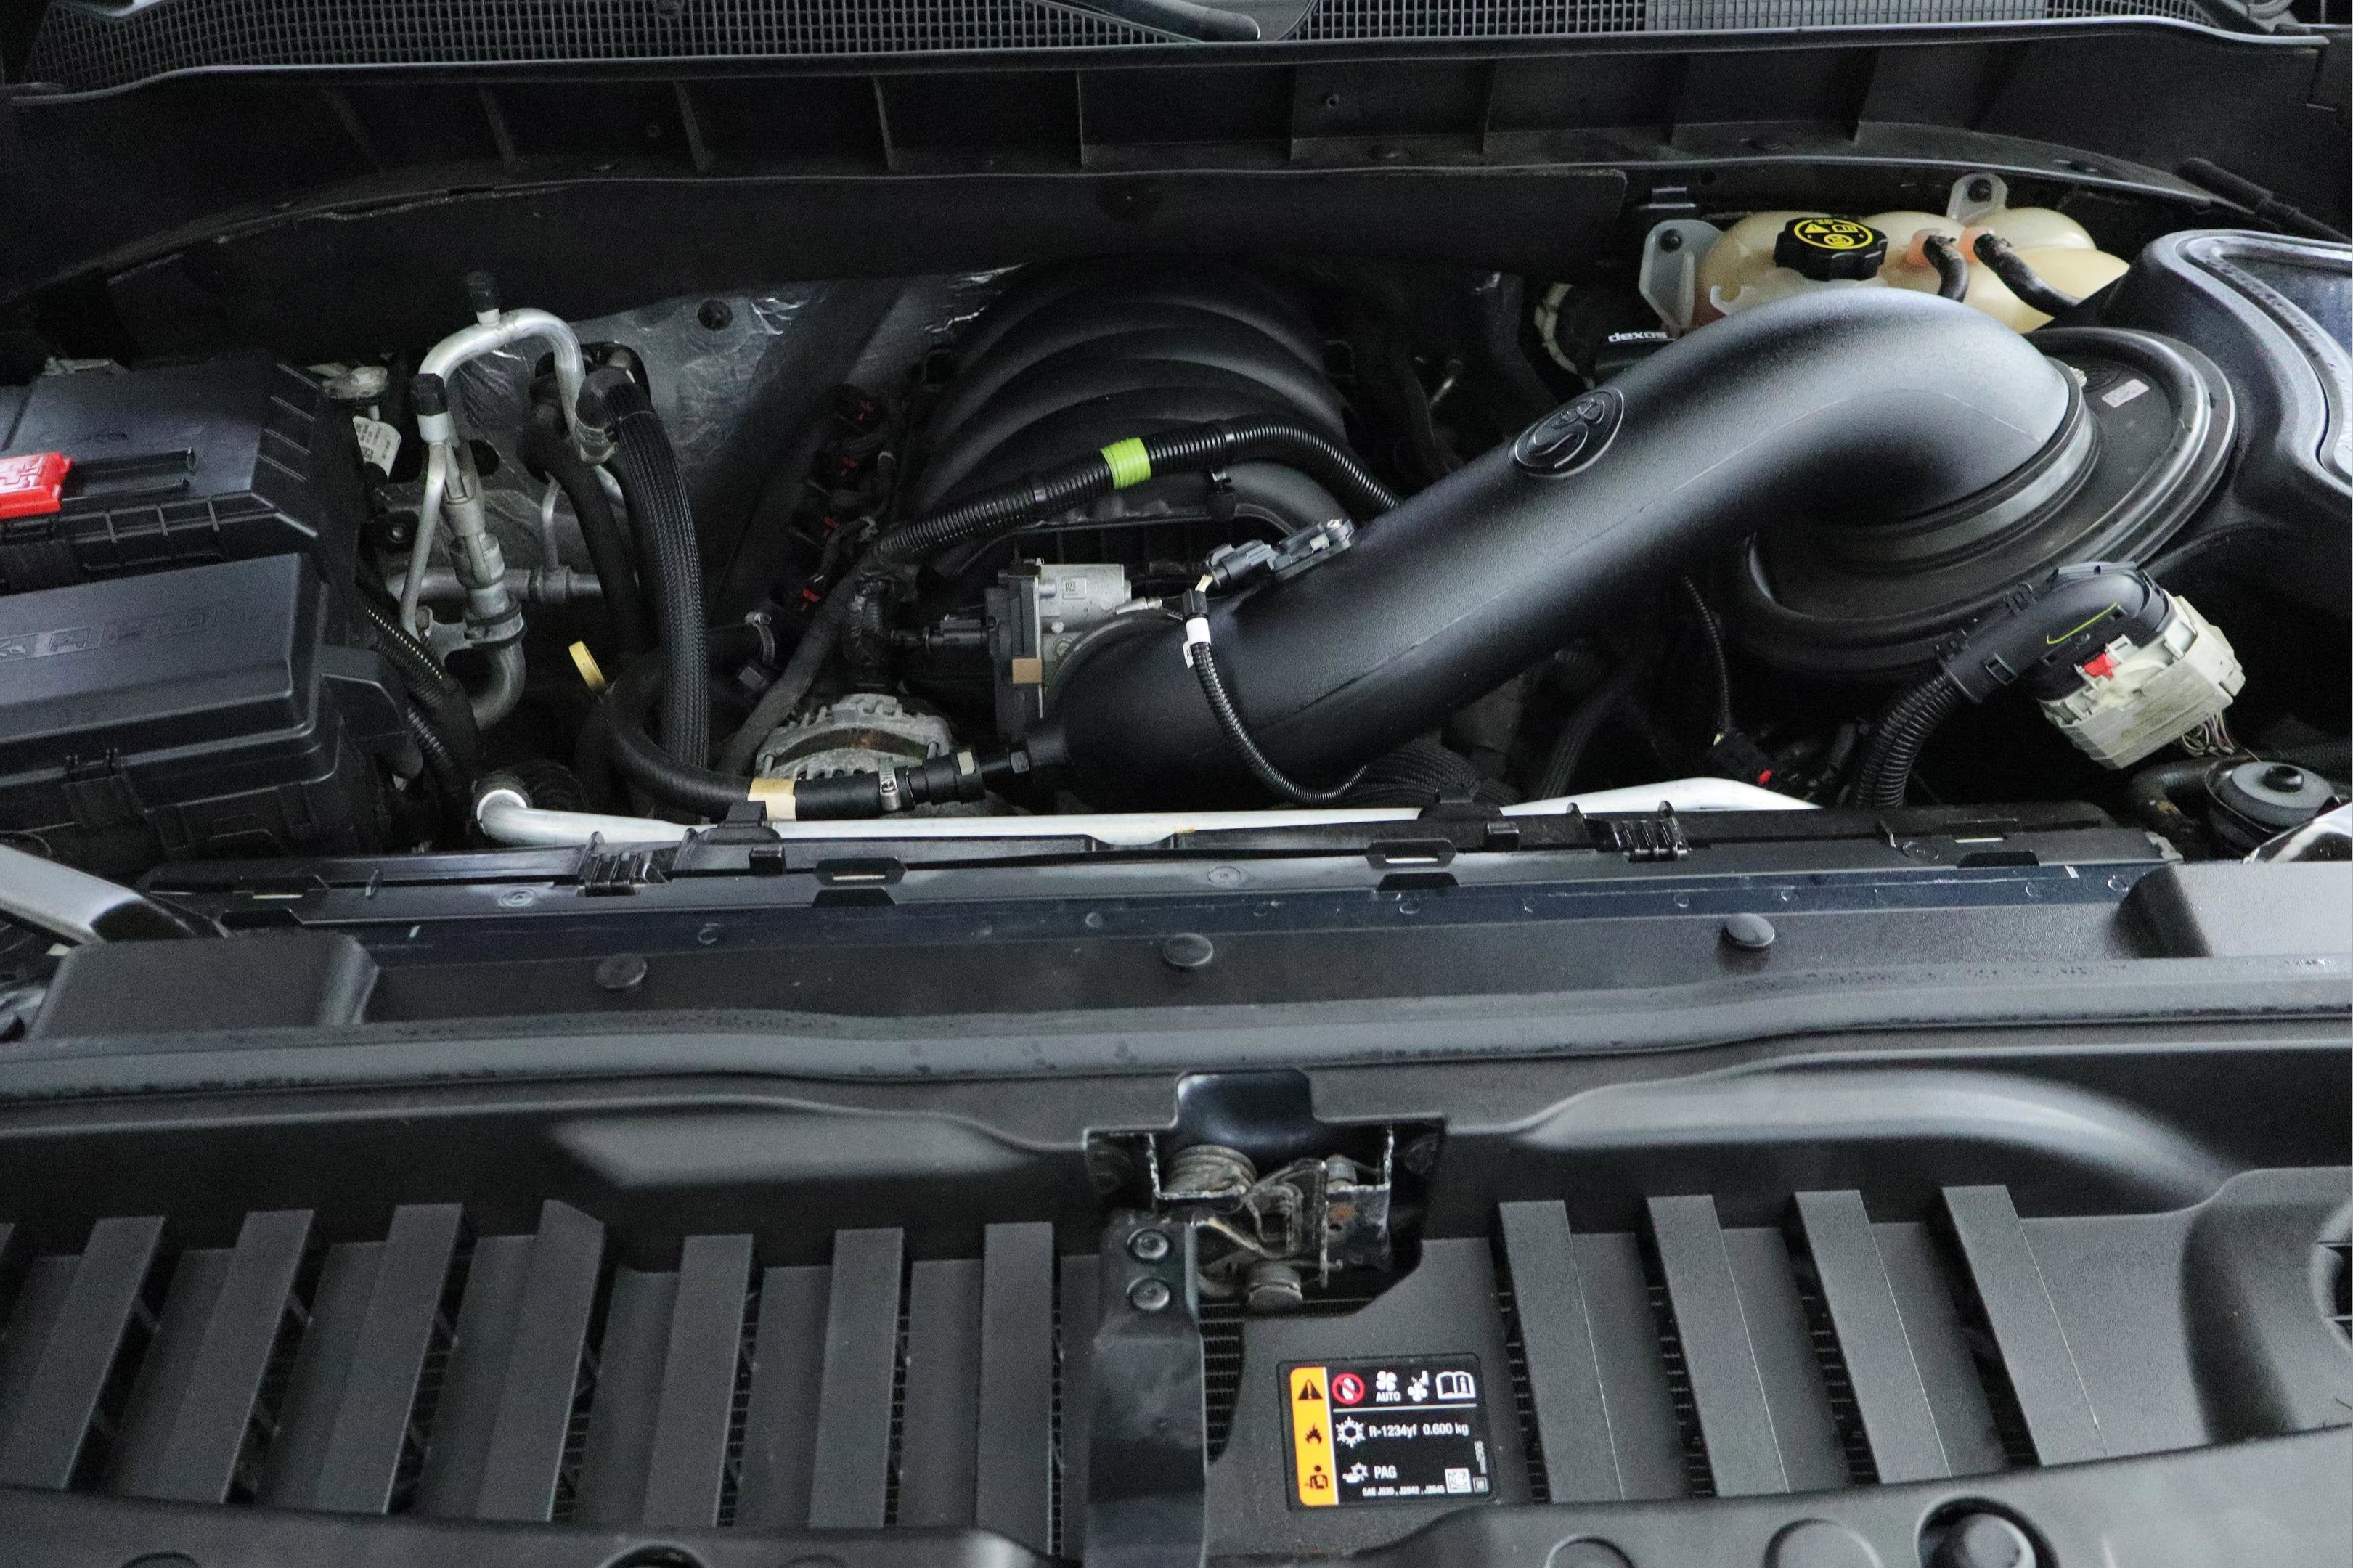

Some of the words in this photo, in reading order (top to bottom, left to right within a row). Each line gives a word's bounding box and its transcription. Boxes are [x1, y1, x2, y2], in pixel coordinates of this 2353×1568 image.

[1608, 332, 1668, 343] dexos
[1376, 1392, 1401, 1402] AUTO
[1369, 1424, 1417, 1438] R-1234yf
[1423, 1423, 1453, 1435] 0.600
[1455, 1422, 1469, 1436] kg
[1374, 1466, 1397, 1479] PAG
